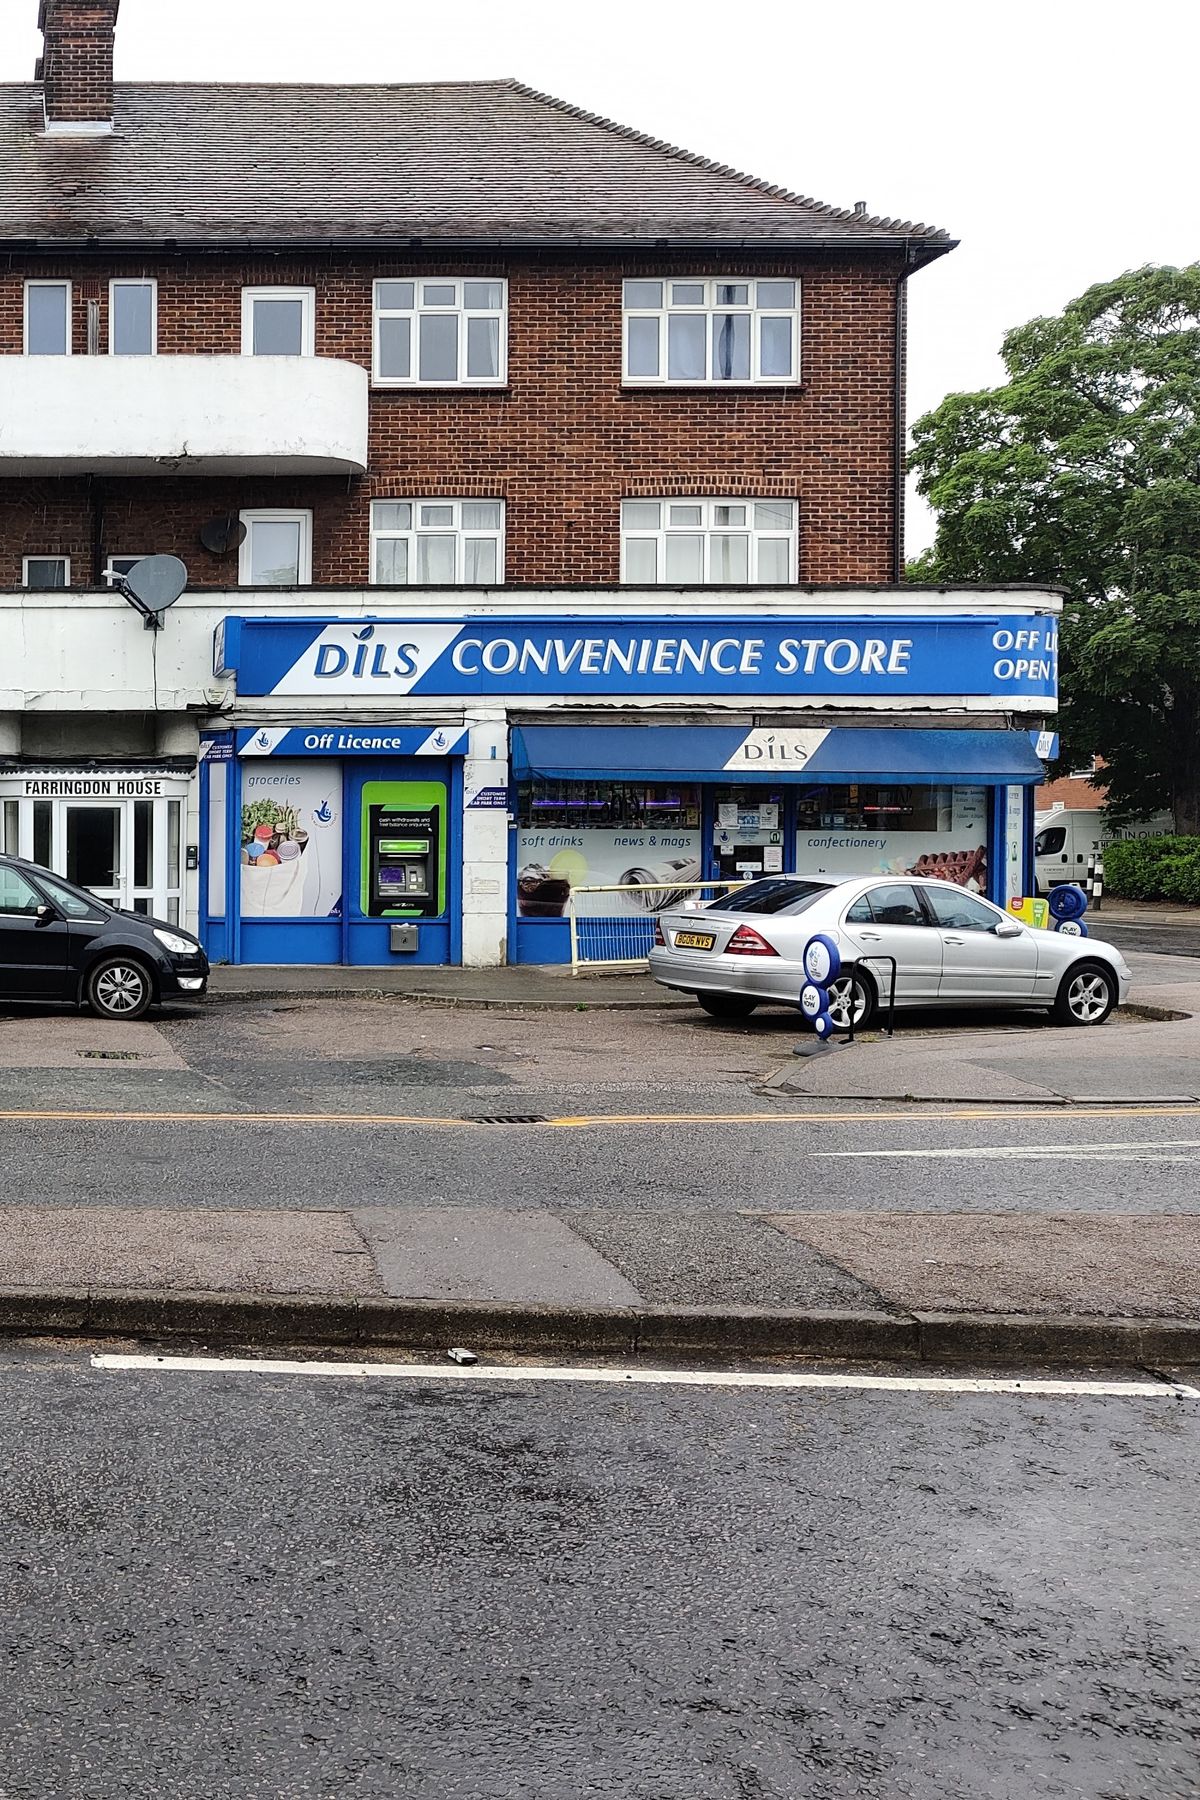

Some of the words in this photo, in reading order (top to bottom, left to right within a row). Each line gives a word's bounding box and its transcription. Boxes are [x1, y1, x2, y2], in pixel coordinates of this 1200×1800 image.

[992, 630, 1040, 651] OFF
[451, 637, 766, 676] CONVENIENCE
[774, 638, 913, 676] STORE
[993, 659, 1051, 680] OPEN
[304, 733, 335, 749] Off
[337, 733, 401, 749] Licence
[744, 741, 808, 760] DILS
[25, 781, 111, 794] FARRINGDON
[117, 781, 161, 794] HOUSE
[248, 774, 301, 787] groceries
[521, 836, 545, 846] soft
[548, 835, 584, 846] drinks
[614, 837, 645, 846] news
[648, 836, 657, 846] &
[660, 837, 692, 848] mags
[807, 837, 887, 848] confectionery
